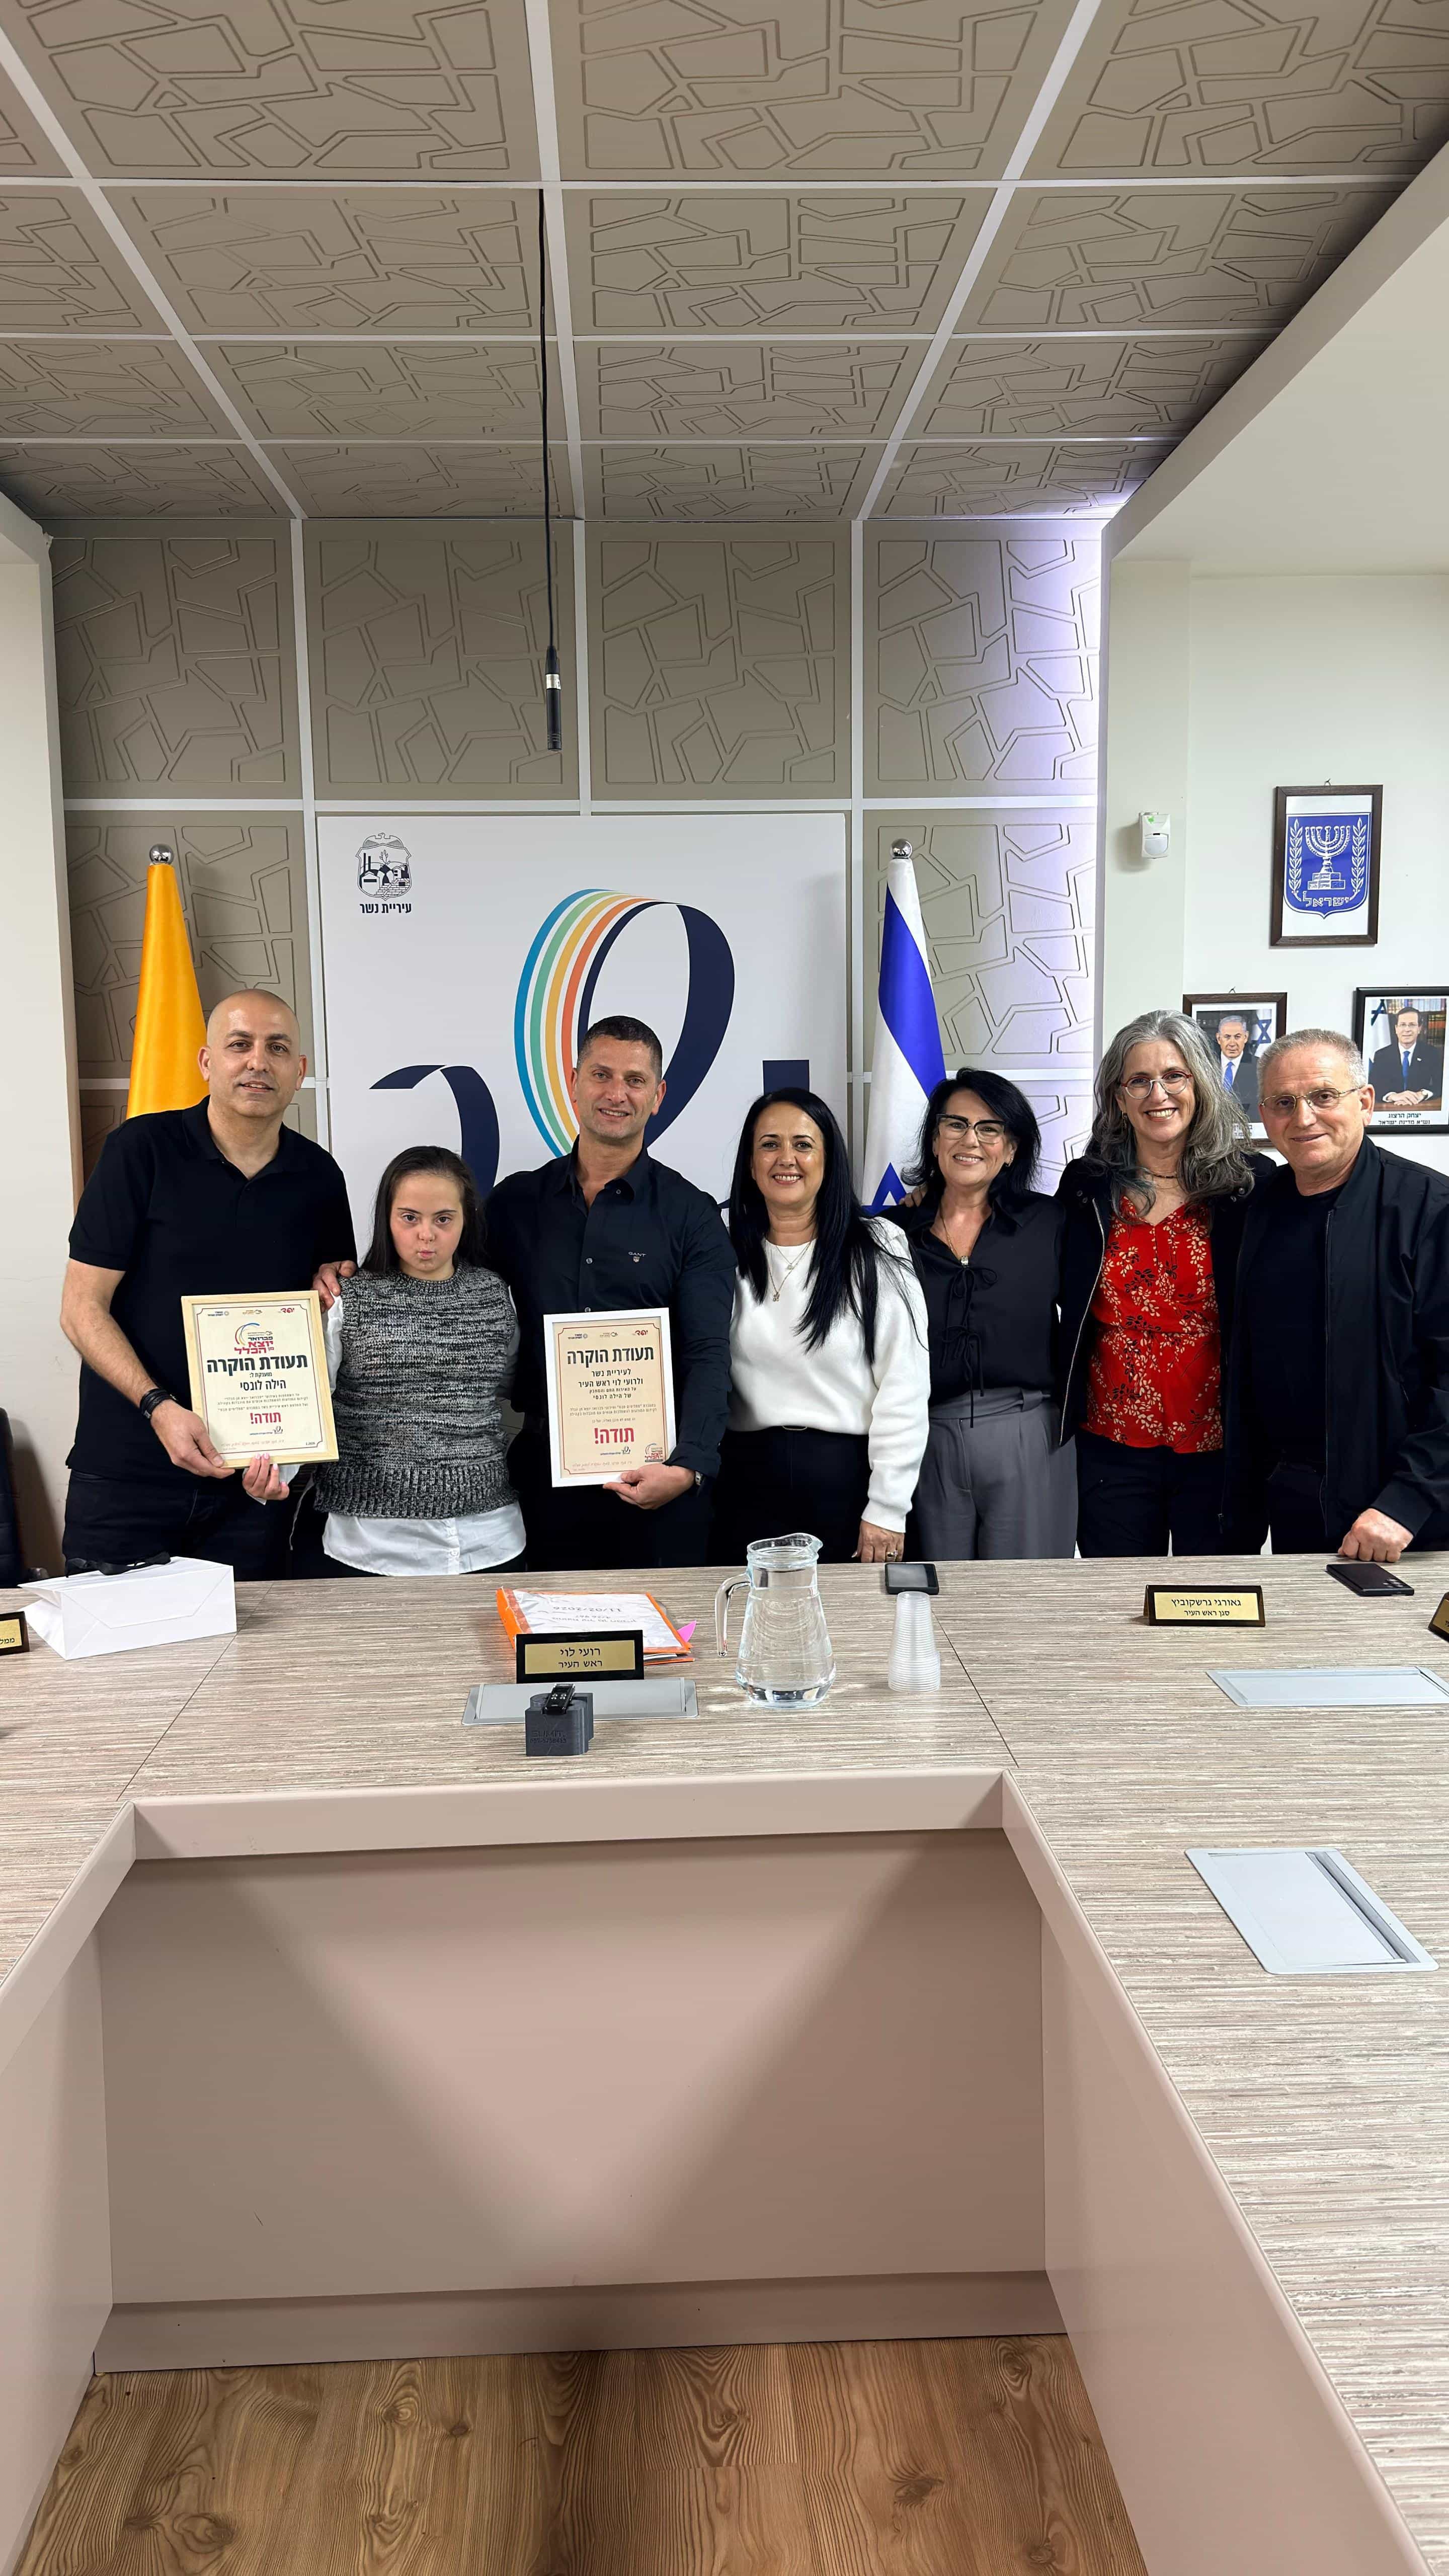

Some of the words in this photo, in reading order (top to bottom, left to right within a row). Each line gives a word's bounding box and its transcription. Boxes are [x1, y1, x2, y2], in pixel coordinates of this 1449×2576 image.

[1303, 891, 1349, 907] ישראל
[359, 904, 379, 913] נשר
[381, 903, 412, 913] עיריית
[567, 1349, 608, 1368] הוקרה
[612, 1347, 654, 1362] תעודת
[207, 1357, 256, 1376] הוקרה
[259, 1354, 308, 1371] תעודת
[265, 1379, 286, 1390] הילה
[250, 1412, 281, 1424] תודה!
[594, 1427, 634, 1444] תודה!
[1171, 1599, 1212, 1607] גרשקוביץ
[560, 1647, 575, 1657] לוי
[579, 1648, 601, 1656] רועי
